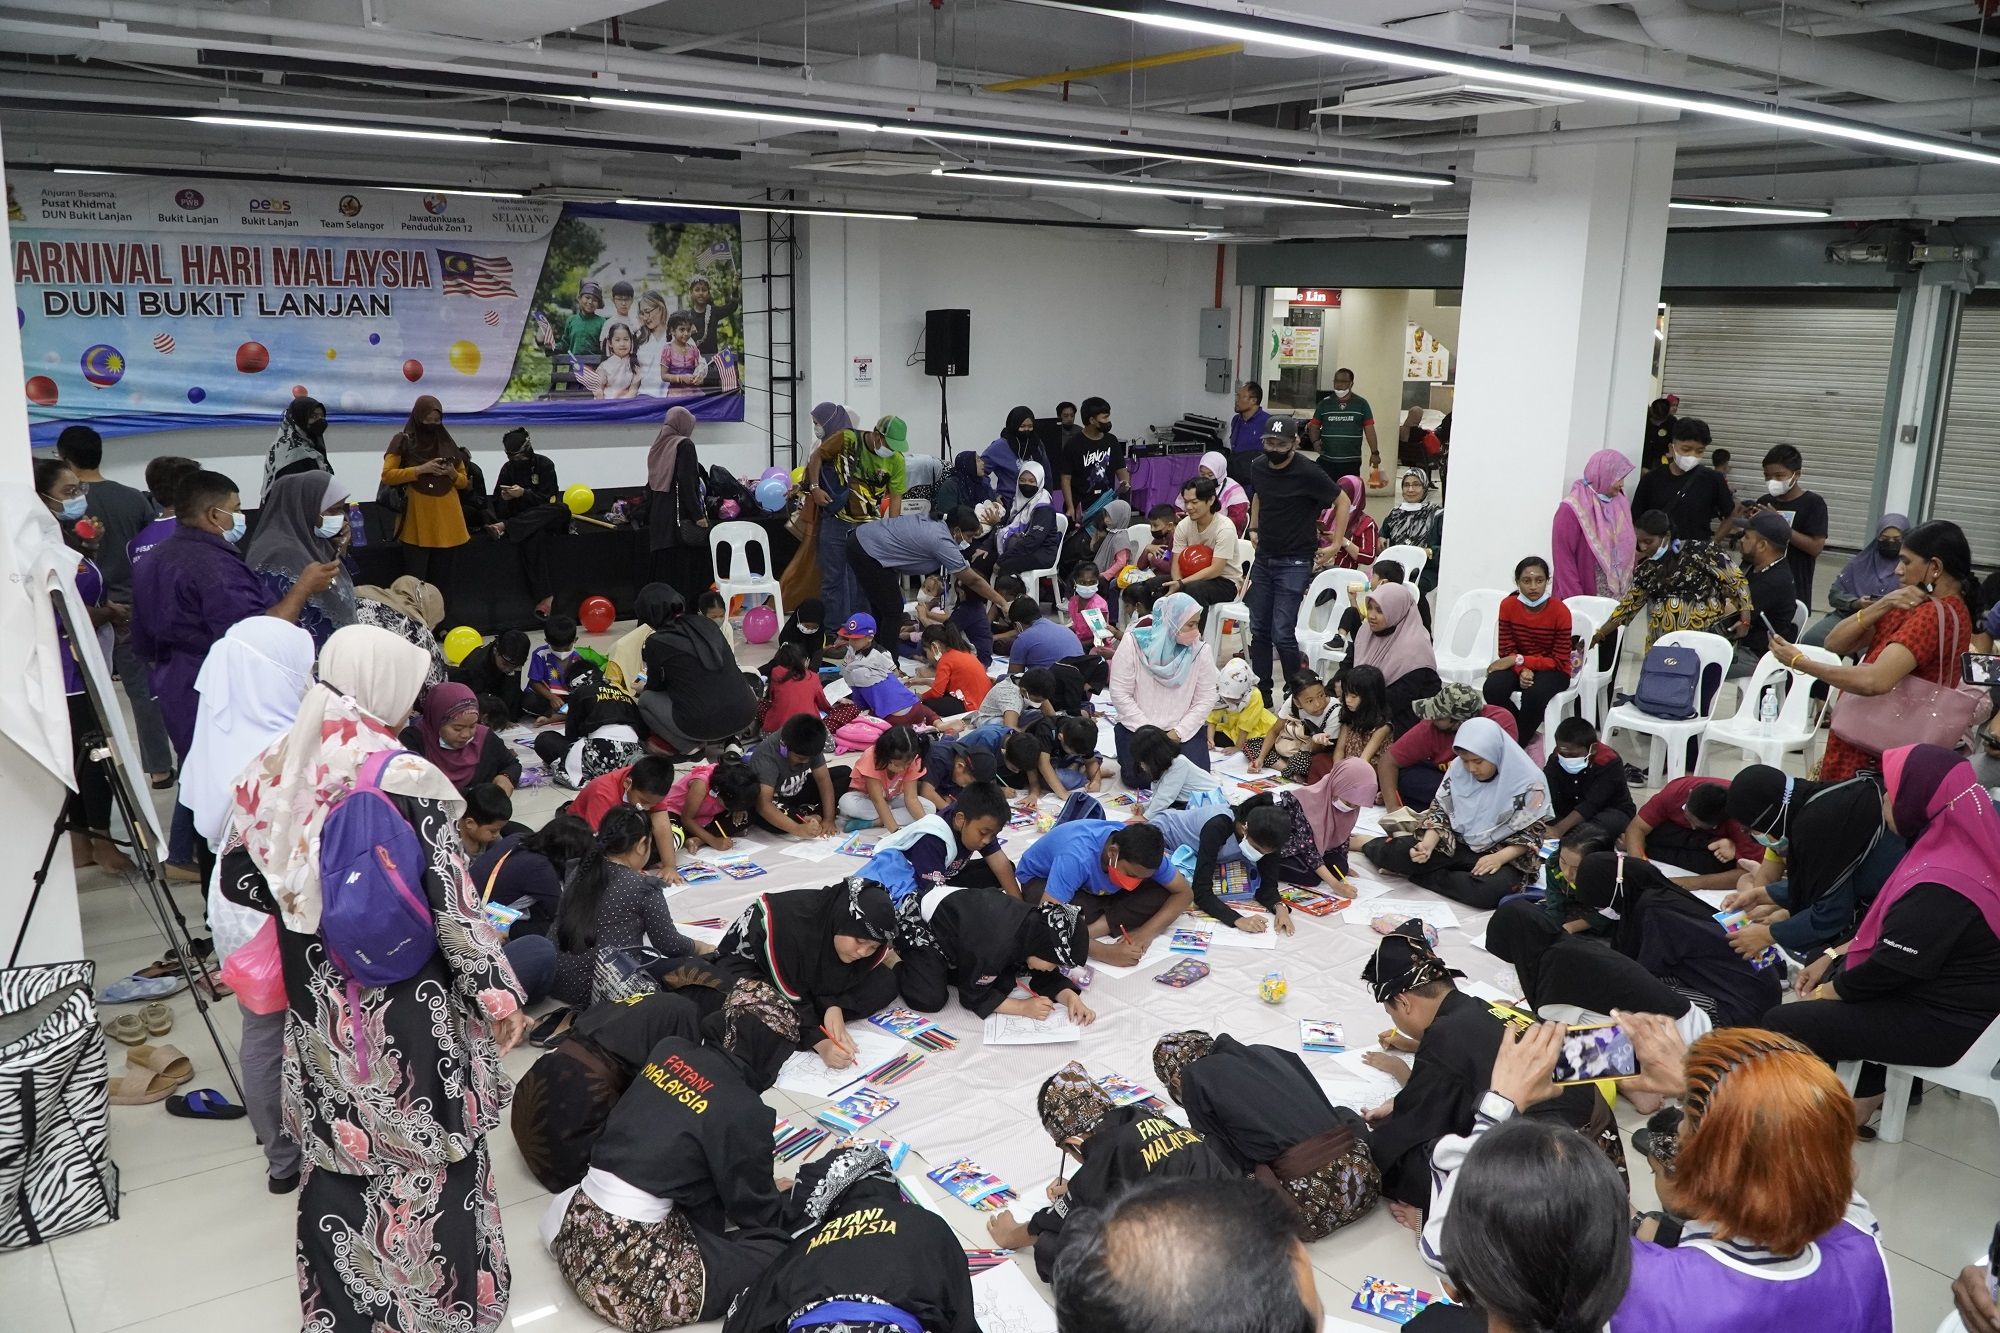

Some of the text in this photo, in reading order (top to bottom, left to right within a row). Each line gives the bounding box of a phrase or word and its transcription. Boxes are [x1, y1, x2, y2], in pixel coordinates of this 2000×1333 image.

[41, 188, 118, 199] Anjuran Bersama:
[41, 199, 117, 210] Pusat Khidmat
[180, 199, 199, 207] PWB
[249, 198, 292, 212] pebs
[42, 210, 133, 223] DUN Bukit Lanjan
[158, 213, 219, 225] Bukit Lanjan
[241, 216, 299, 229] Bukit Lanjan
[408, 214, 466, 224] Jawatankuasa
[492, 212, 549, 224] SELAYANG
[320, 219, 385, 231] Team Selangor
[401, 222, 473, 233] Penduduk Zon 12
[506, 223, 538, 233] MALL
[15, 240, 432, 289] ARNIVAL HARI MALAYSIA
[1305, 291, 1327, 302] Lin
[42, 290, 392, 318] DUN BUKIT LANJAN
[663, 1054, 715, 1094] FATANI
[640, 1062, 709, 1115] MALAYSIA
[821, 1207, 884, 1232] FATANI
[805, 1220, 897, 1255] MALAYSIA
